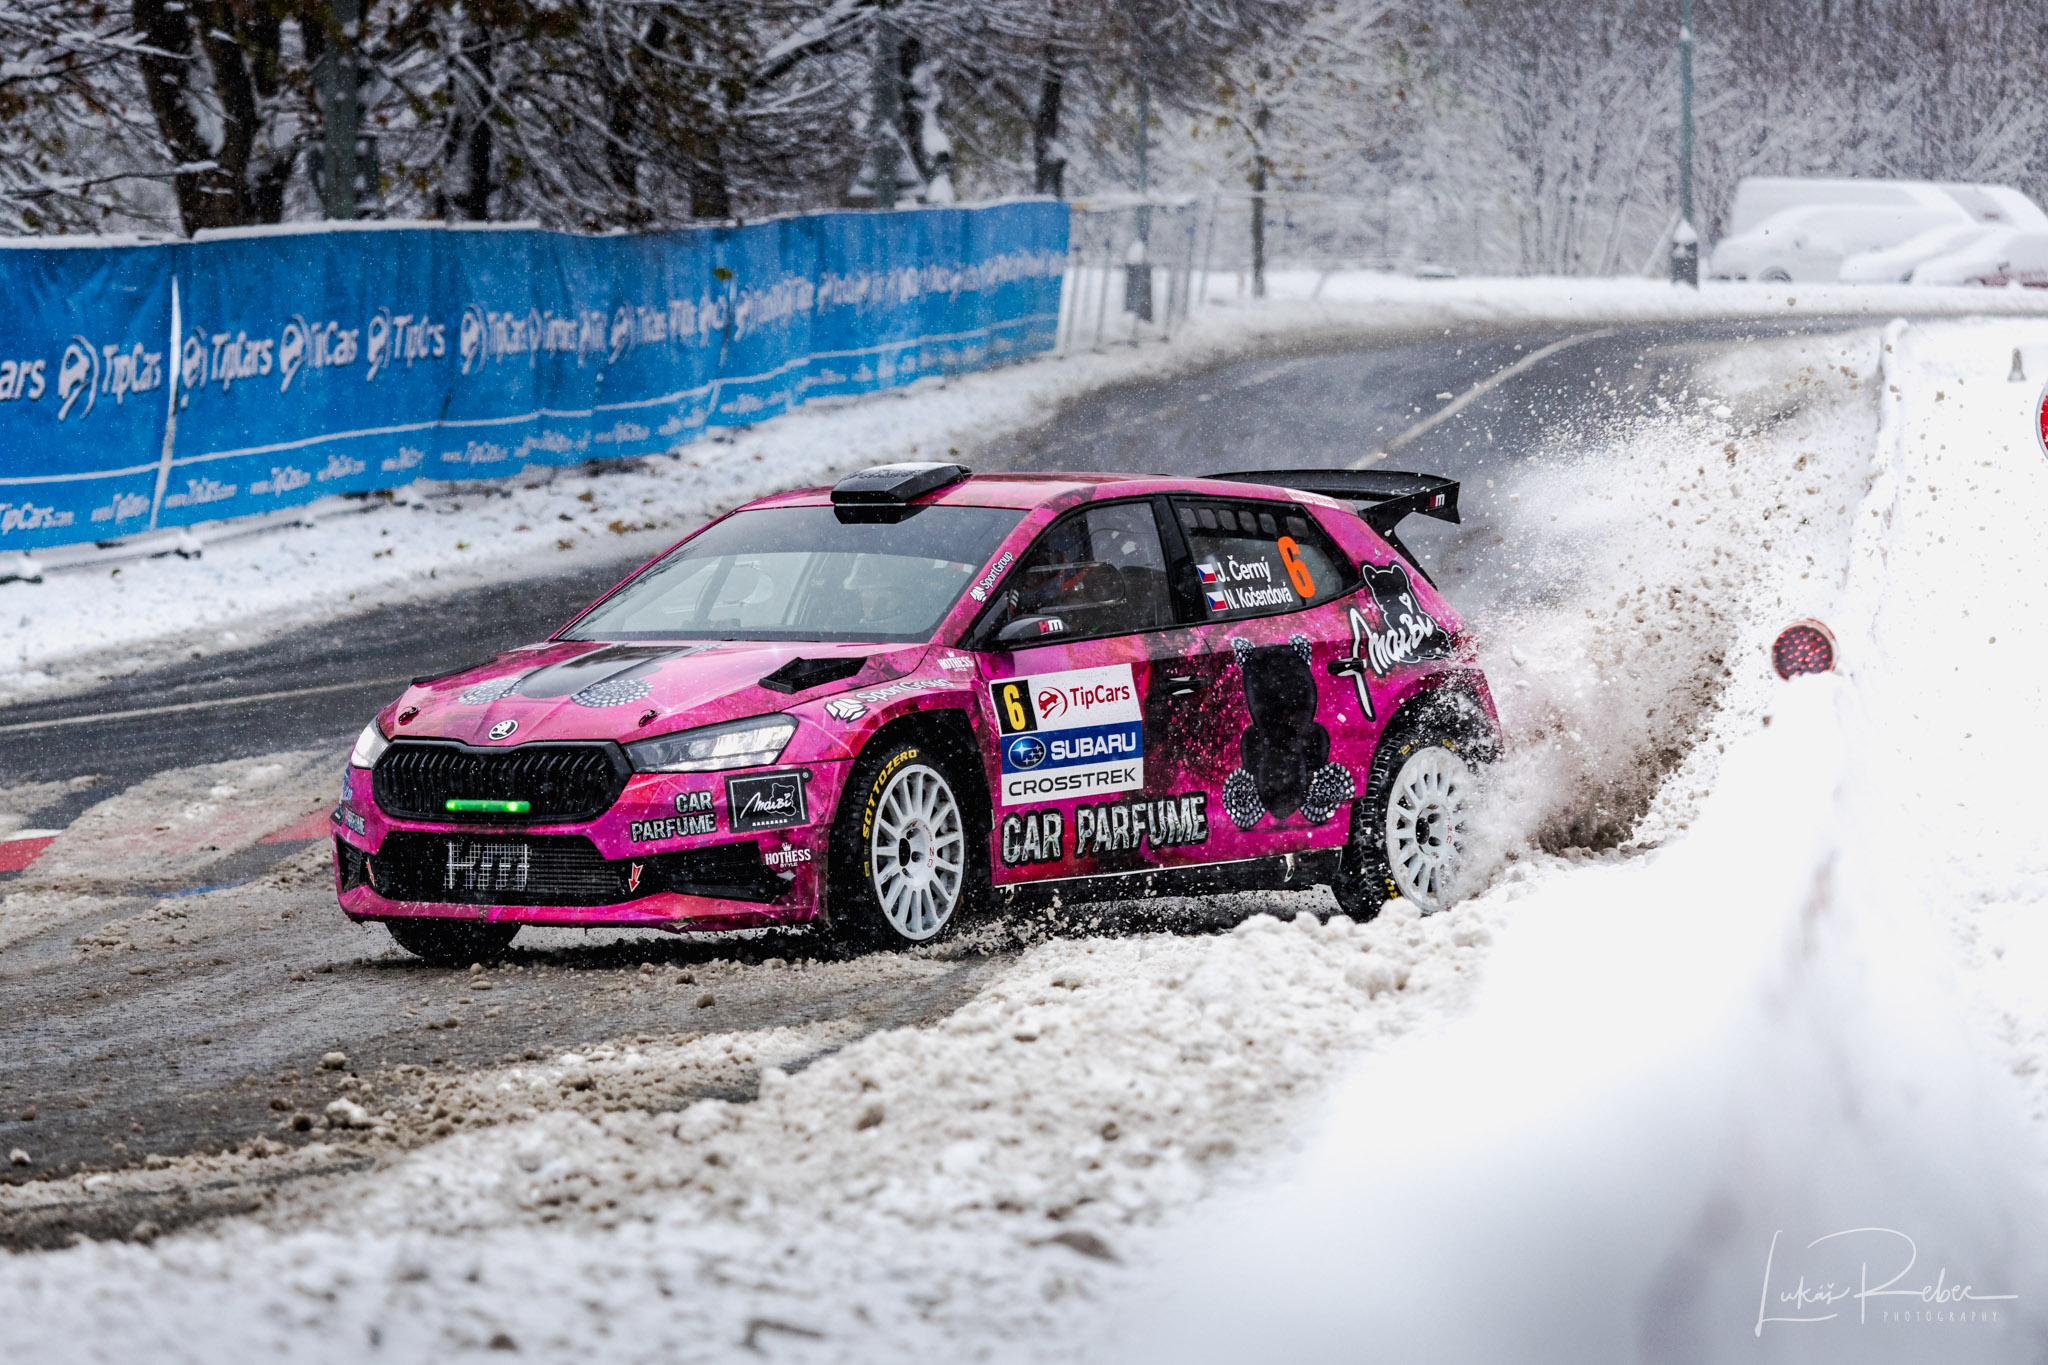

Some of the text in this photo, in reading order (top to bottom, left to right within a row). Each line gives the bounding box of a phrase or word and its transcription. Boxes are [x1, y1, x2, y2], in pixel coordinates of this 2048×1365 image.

[979, 551, 1015, 588] SportGroup
[1217, 555, 1272, 583] J. Černý
[1278, 536, 1315, 599] 6
[1224, 581, 1294, 610] N. Kočendová
[856, 678, 958, 703] SportGroup
[1003, 684, 1130, 731] 6 TipCars
[1050, 732, 1137, 761] SUBARU
[862, 748, 919, 840] SOTTOZERO
[1008, 767, 1137, 797] CROSSTREK
[675, 790, 713, 813] CAR
[630, 813, 718, 842] PARFUME
[1003, 795, 1209, 864] CAR PARFUME
[765, 848, 812, 866] HOTHESS
